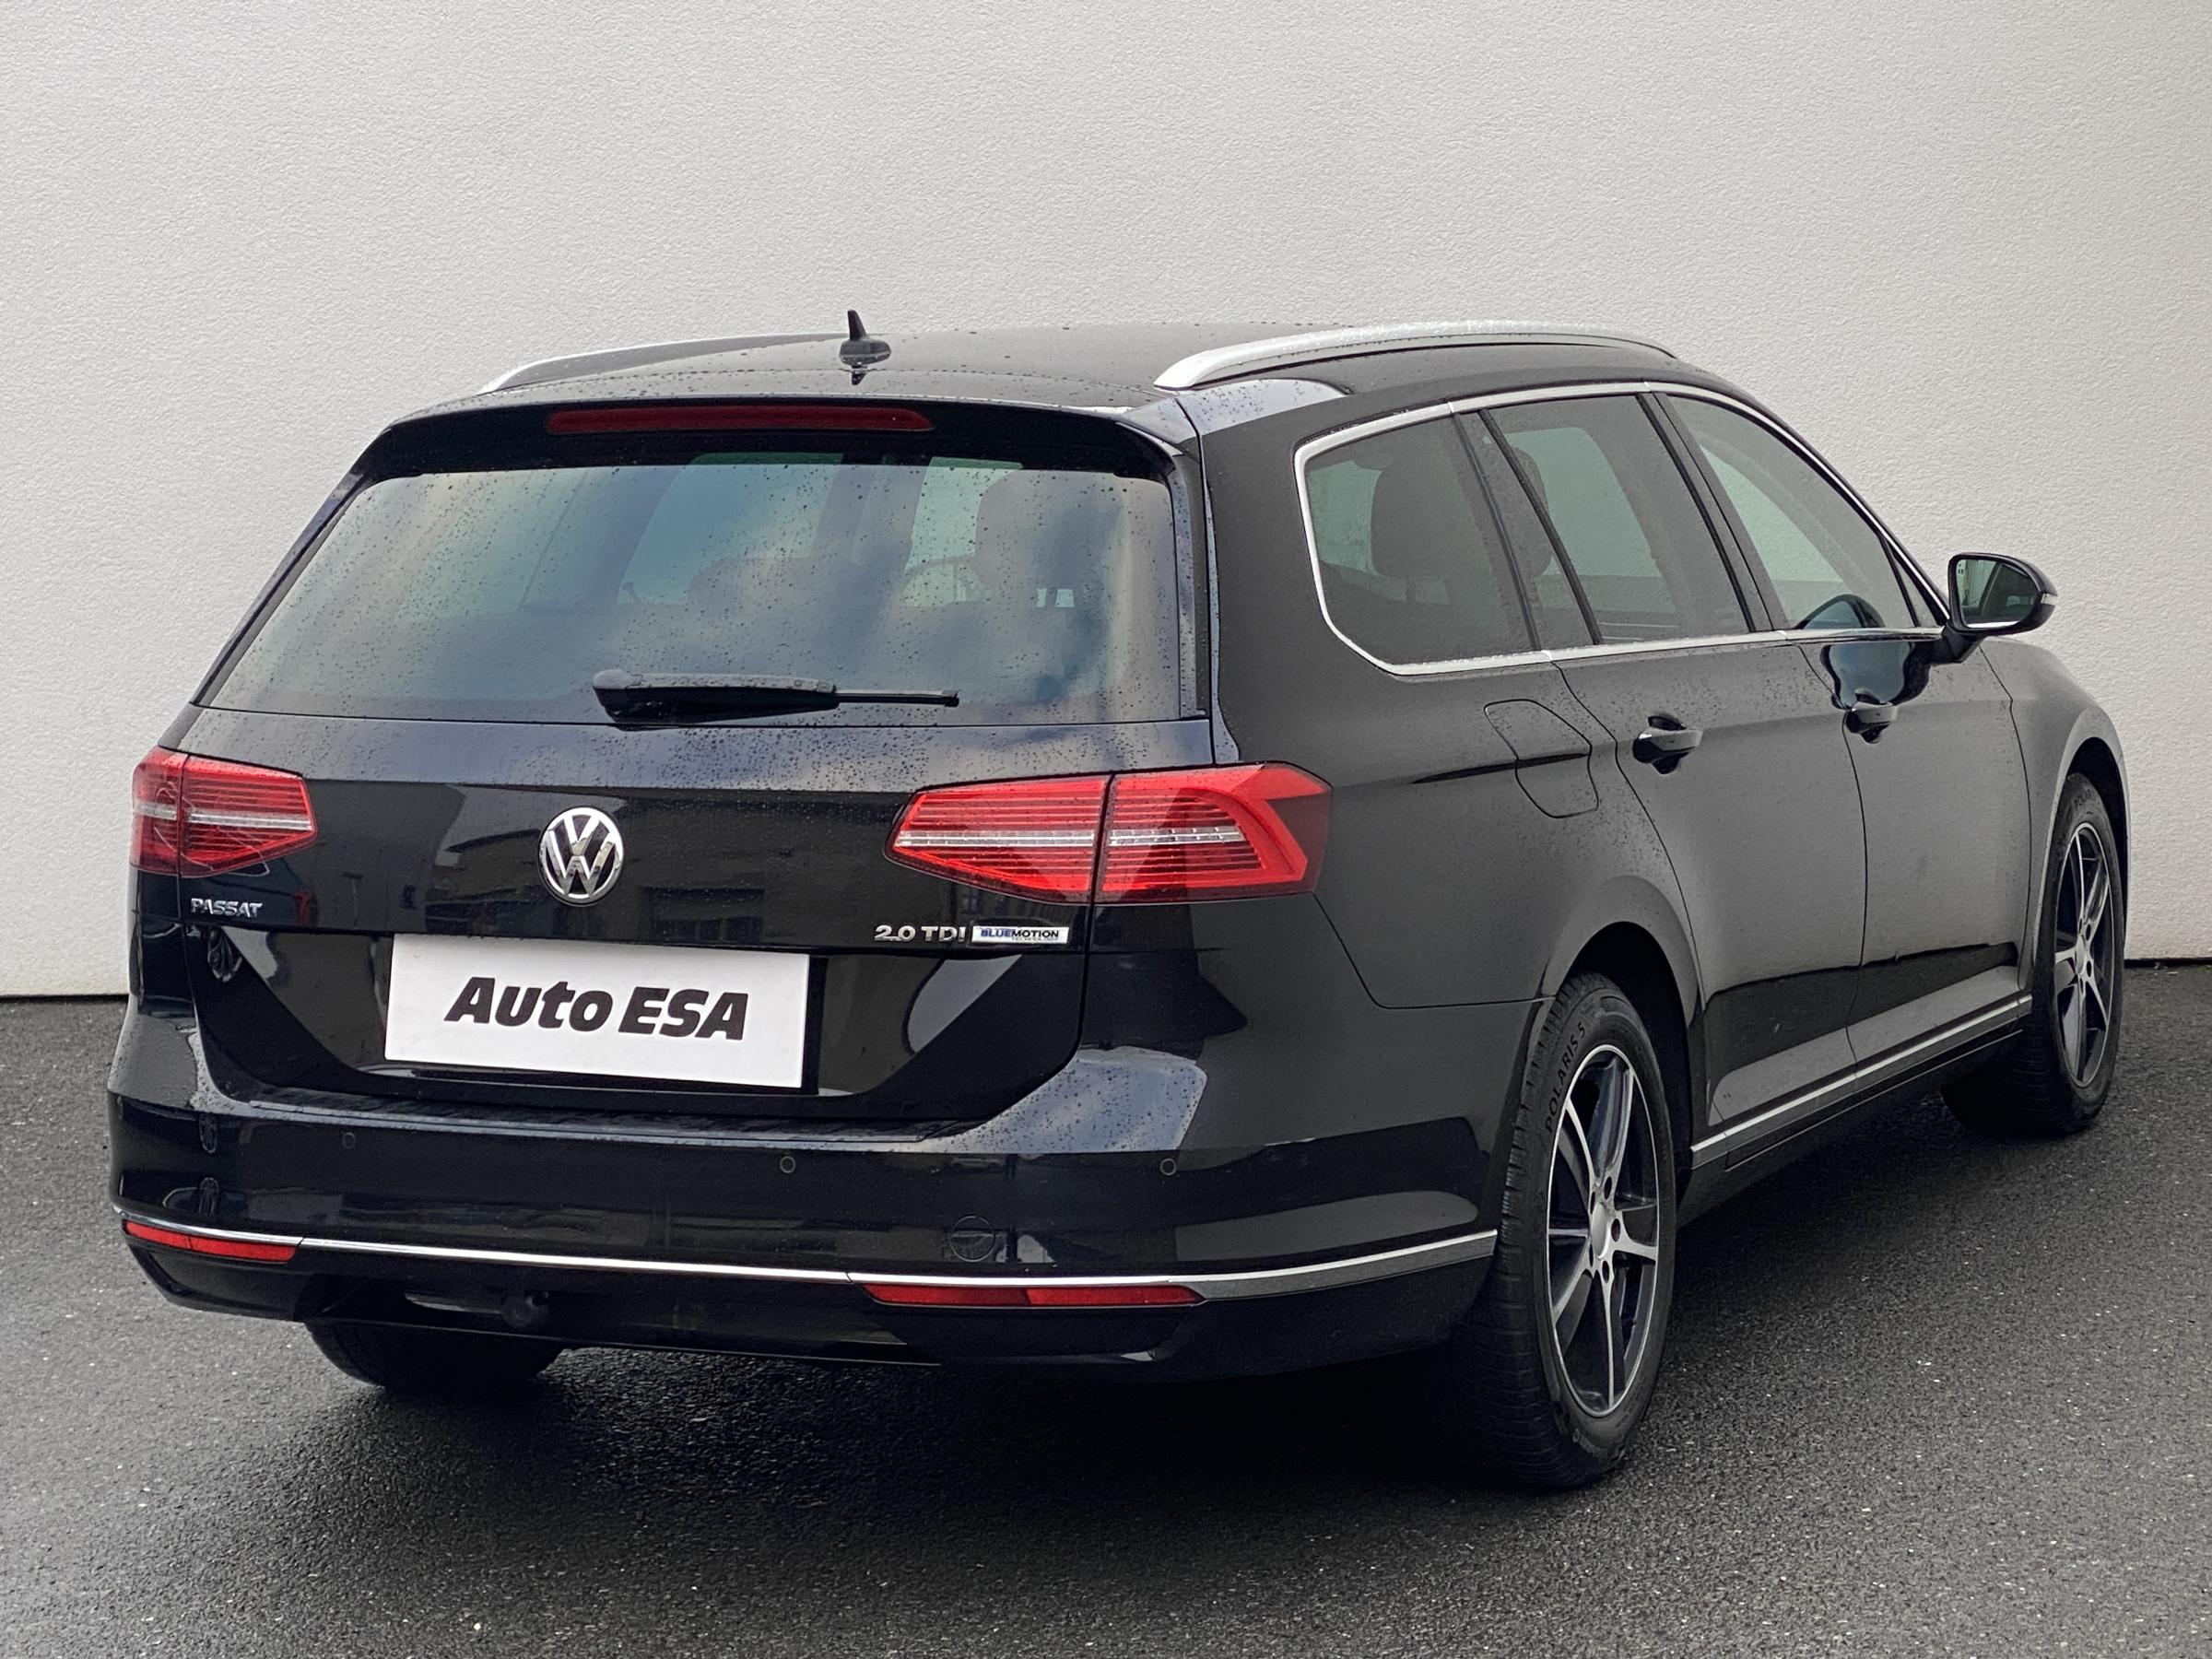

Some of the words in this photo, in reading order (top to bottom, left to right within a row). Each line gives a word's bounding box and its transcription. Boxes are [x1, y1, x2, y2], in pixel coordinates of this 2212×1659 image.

[539, 807, 623, 903] VW
[191, 897, 263, 918] PASSAT
[875, 924, 916, 942] 2.0
[921, 925, 966, 942] TDI
[980, 928, 1059, 938] BLUEMOTION
[443, 976, 614, 1032] Auto
[618, 986, 749, 1041] ESA
[1545, 1034, 1579, 1134] POLARIS
